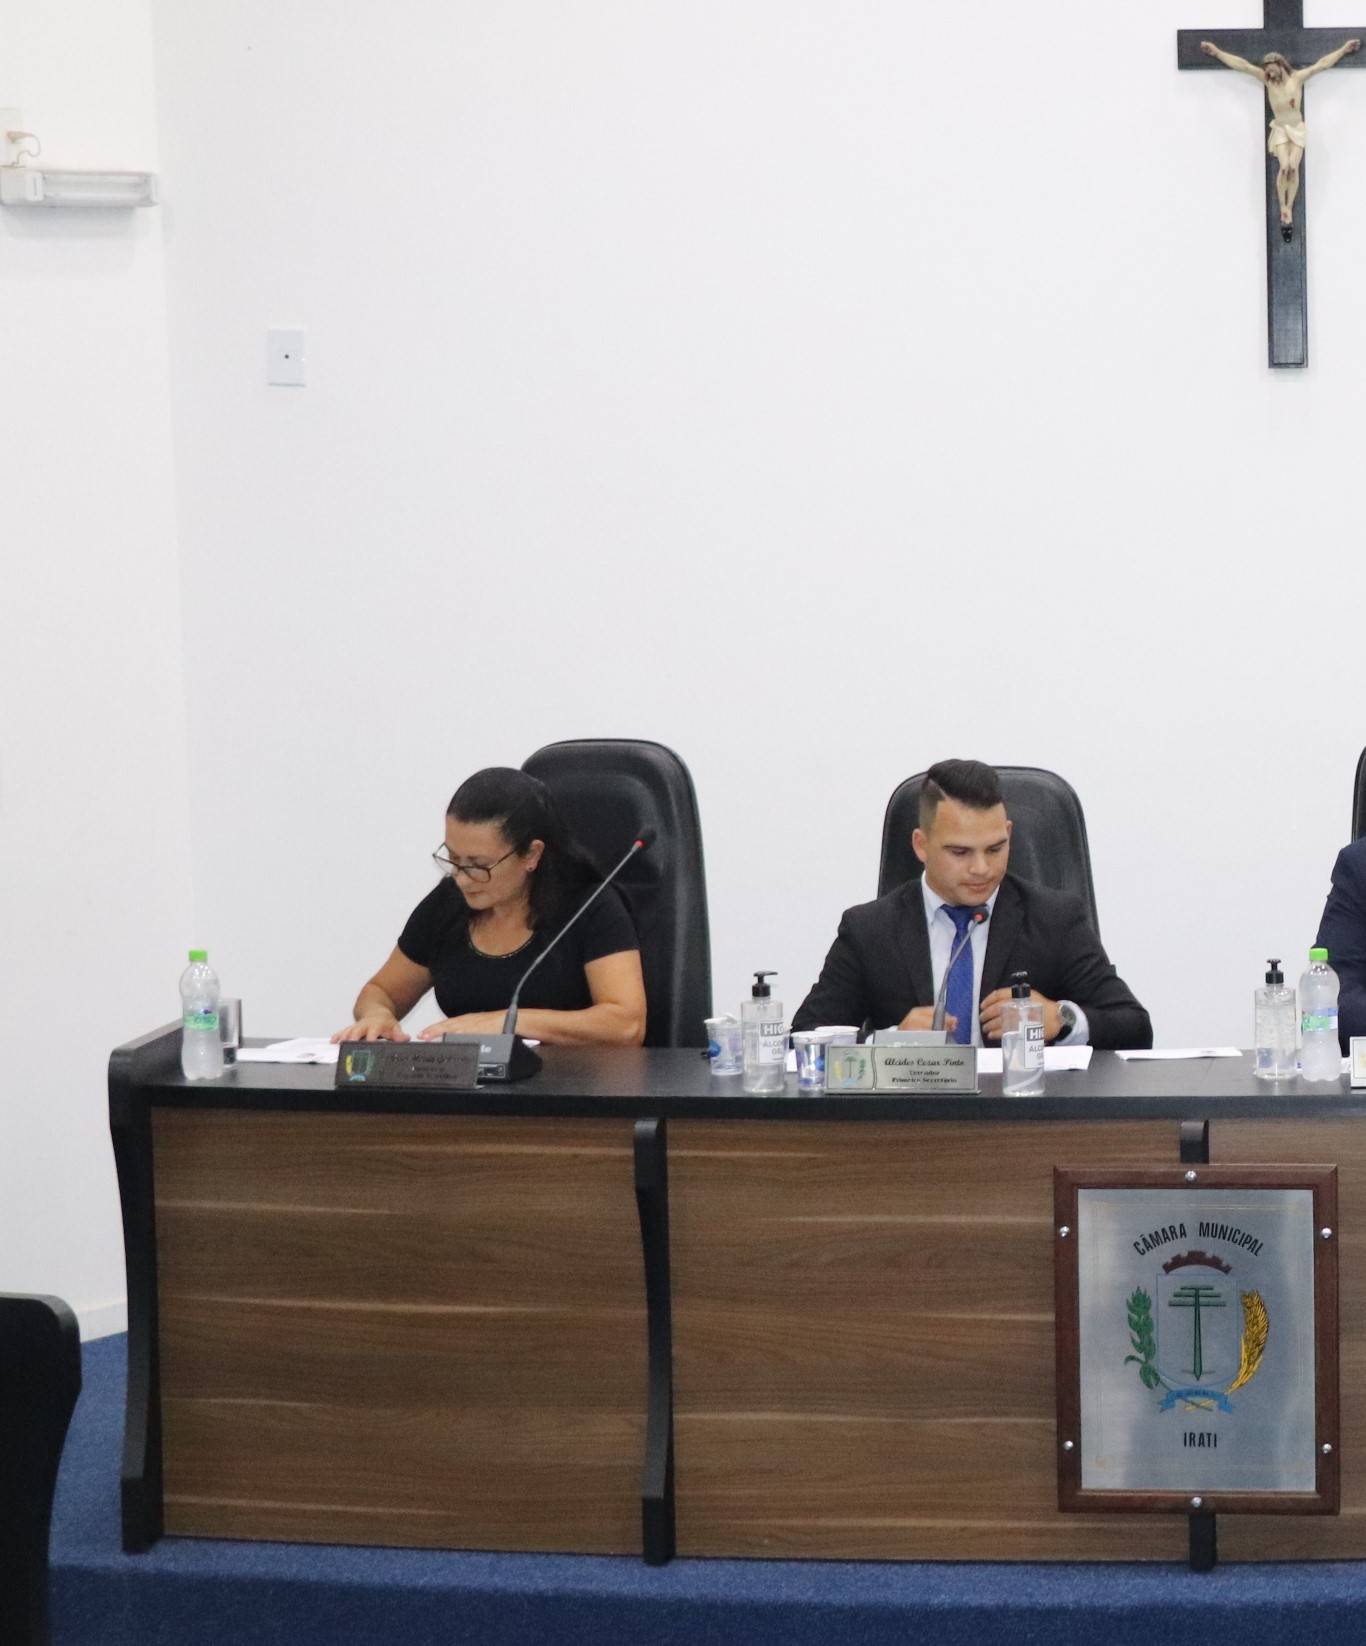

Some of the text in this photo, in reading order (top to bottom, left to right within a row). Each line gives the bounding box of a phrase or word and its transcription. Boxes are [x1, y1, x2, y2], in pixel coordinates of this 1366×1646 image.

[884, 1057, 915, 1066] Alcides
[943, 1057, 965, 1066] Pinto
[1133, 1222, 1264, 1257] CÂMARA MUNICIPAL
[1184, 1432, 1217, 1447] IRATI
